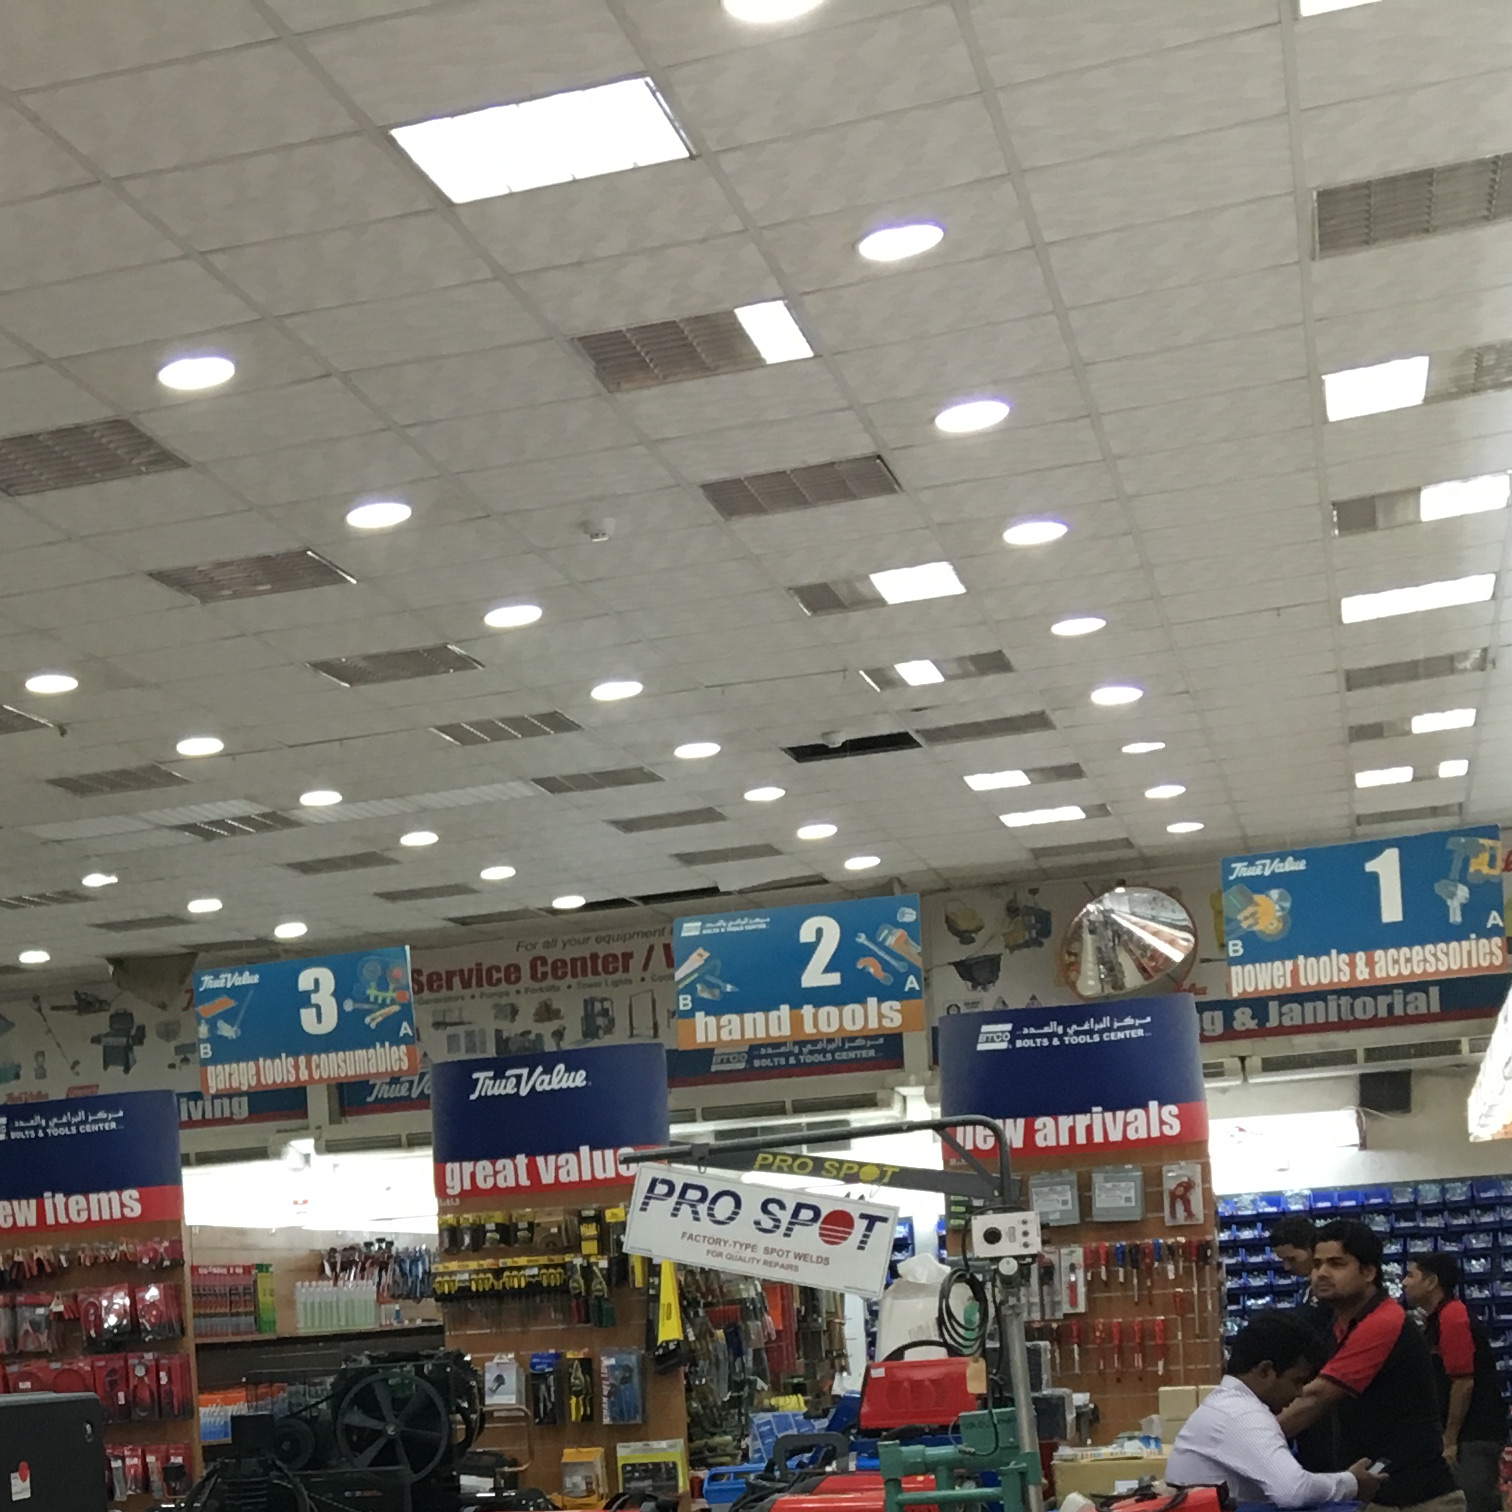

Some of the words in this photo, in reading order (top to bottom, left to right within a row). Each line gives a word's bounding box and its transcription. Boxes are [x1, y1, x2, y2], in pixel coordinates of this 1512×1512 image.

[1365, 848, 1403, 923] 1
[1486, 910, 1504, 928] A
[516, 940, 538, 952] For
[542, 936, 557, 949] all
[561, 936, 590, 950] your
[594, 926, 667, 945] equipment
[799, 915, 841, 988] 2
[1228, 940, 1244, 957] B
[411, 962, 521, 995] Service
[529, 950, 634, 983] Center
[1231, 960, 1293, 997] power
[1297, 949, 1350, 986] tools
[1355, 951, 1370, 980] &
[1374, 933, 1503, 978] accessories
[904, 975, 920, 991] A
[298, 966, 338, 1035] 3
[679, 994, 692, 1010] B
[1233, 1007, 1258, 1031] &
[1266, 986, 1440, 1027] Janitorial
[398, 1021, 413, 1037] A
[695, 1004, 791, 1043] hand
[801, 997, 902, 1034] tools
[200, 1043, 212, 1059] B
[978, 1032, 1011, 1043] BTCO
[1016, 1038, 1049, 1048] BOLTS
[1052, 1037, 1060, 1047] &
[1064, 1033, 1100, 1044] TOOLS
[1103, 1028, 1144, 1041] CENTER
[207, 1059, 257, 1094] garage
[258, 1052, 296, 1085] tools
[298, 1055, 309, 1081] &
[311, 1041, 409, 1080] consumables
[753, 1056, 785, 1067] BOLTS
[799, 1052, 832, 1064] TOOLS
[834, 1049, 876, 1061] CENTER
[46, 1126, 77, 1137] TOOLS
[80, 1122, 117, 1134] CENTER
[1035, 1100, 1181, 1147] arrivals
[445, 1153, 530, 1196] great
[753, 1152, 814, 1175] PRO
[821, 1158, 899, 1183] SPOT
[43, 1189, 142, 1226] items
[639, 1176, 742, 1226] PRO
[753, 1197, 889, 1251] SPOT
[706, 1249, 724, 1258] FOR
[725, 1252, 761, 1266] QUALITY
[763, 1258, 799, 1273] REPAIRS
[763, 1246, 791, 1258] SPOT
[793, 1251, 830, 1266] WELDS
